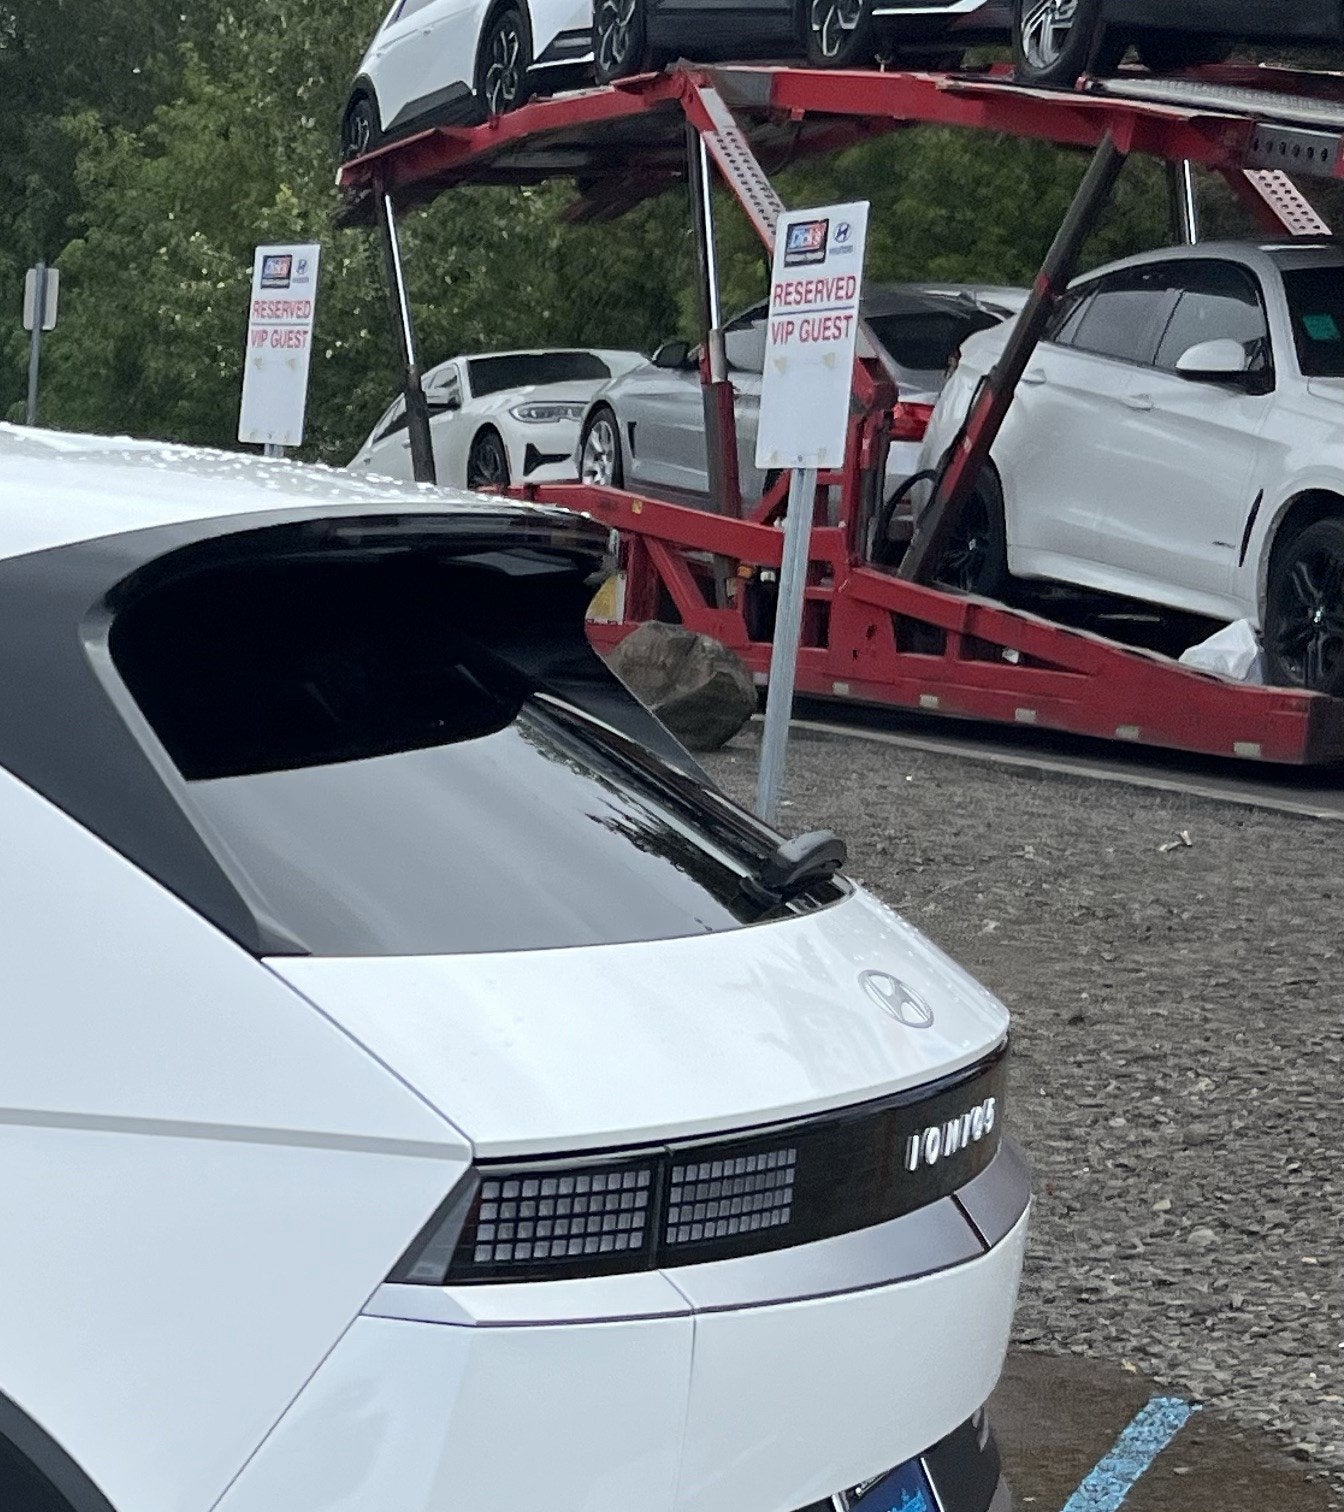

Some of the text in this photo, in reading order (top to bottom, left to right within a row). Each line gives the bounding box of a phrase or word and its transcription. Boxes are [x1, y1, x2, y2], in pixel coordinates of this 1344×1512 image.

[773, 275, 857, 307] RESERVED
[252, 300, 311, 319] RESERVED
[250, 330, 309, 349] VIP GUEST
[771, 315, 853, 345] VIP GUEST
